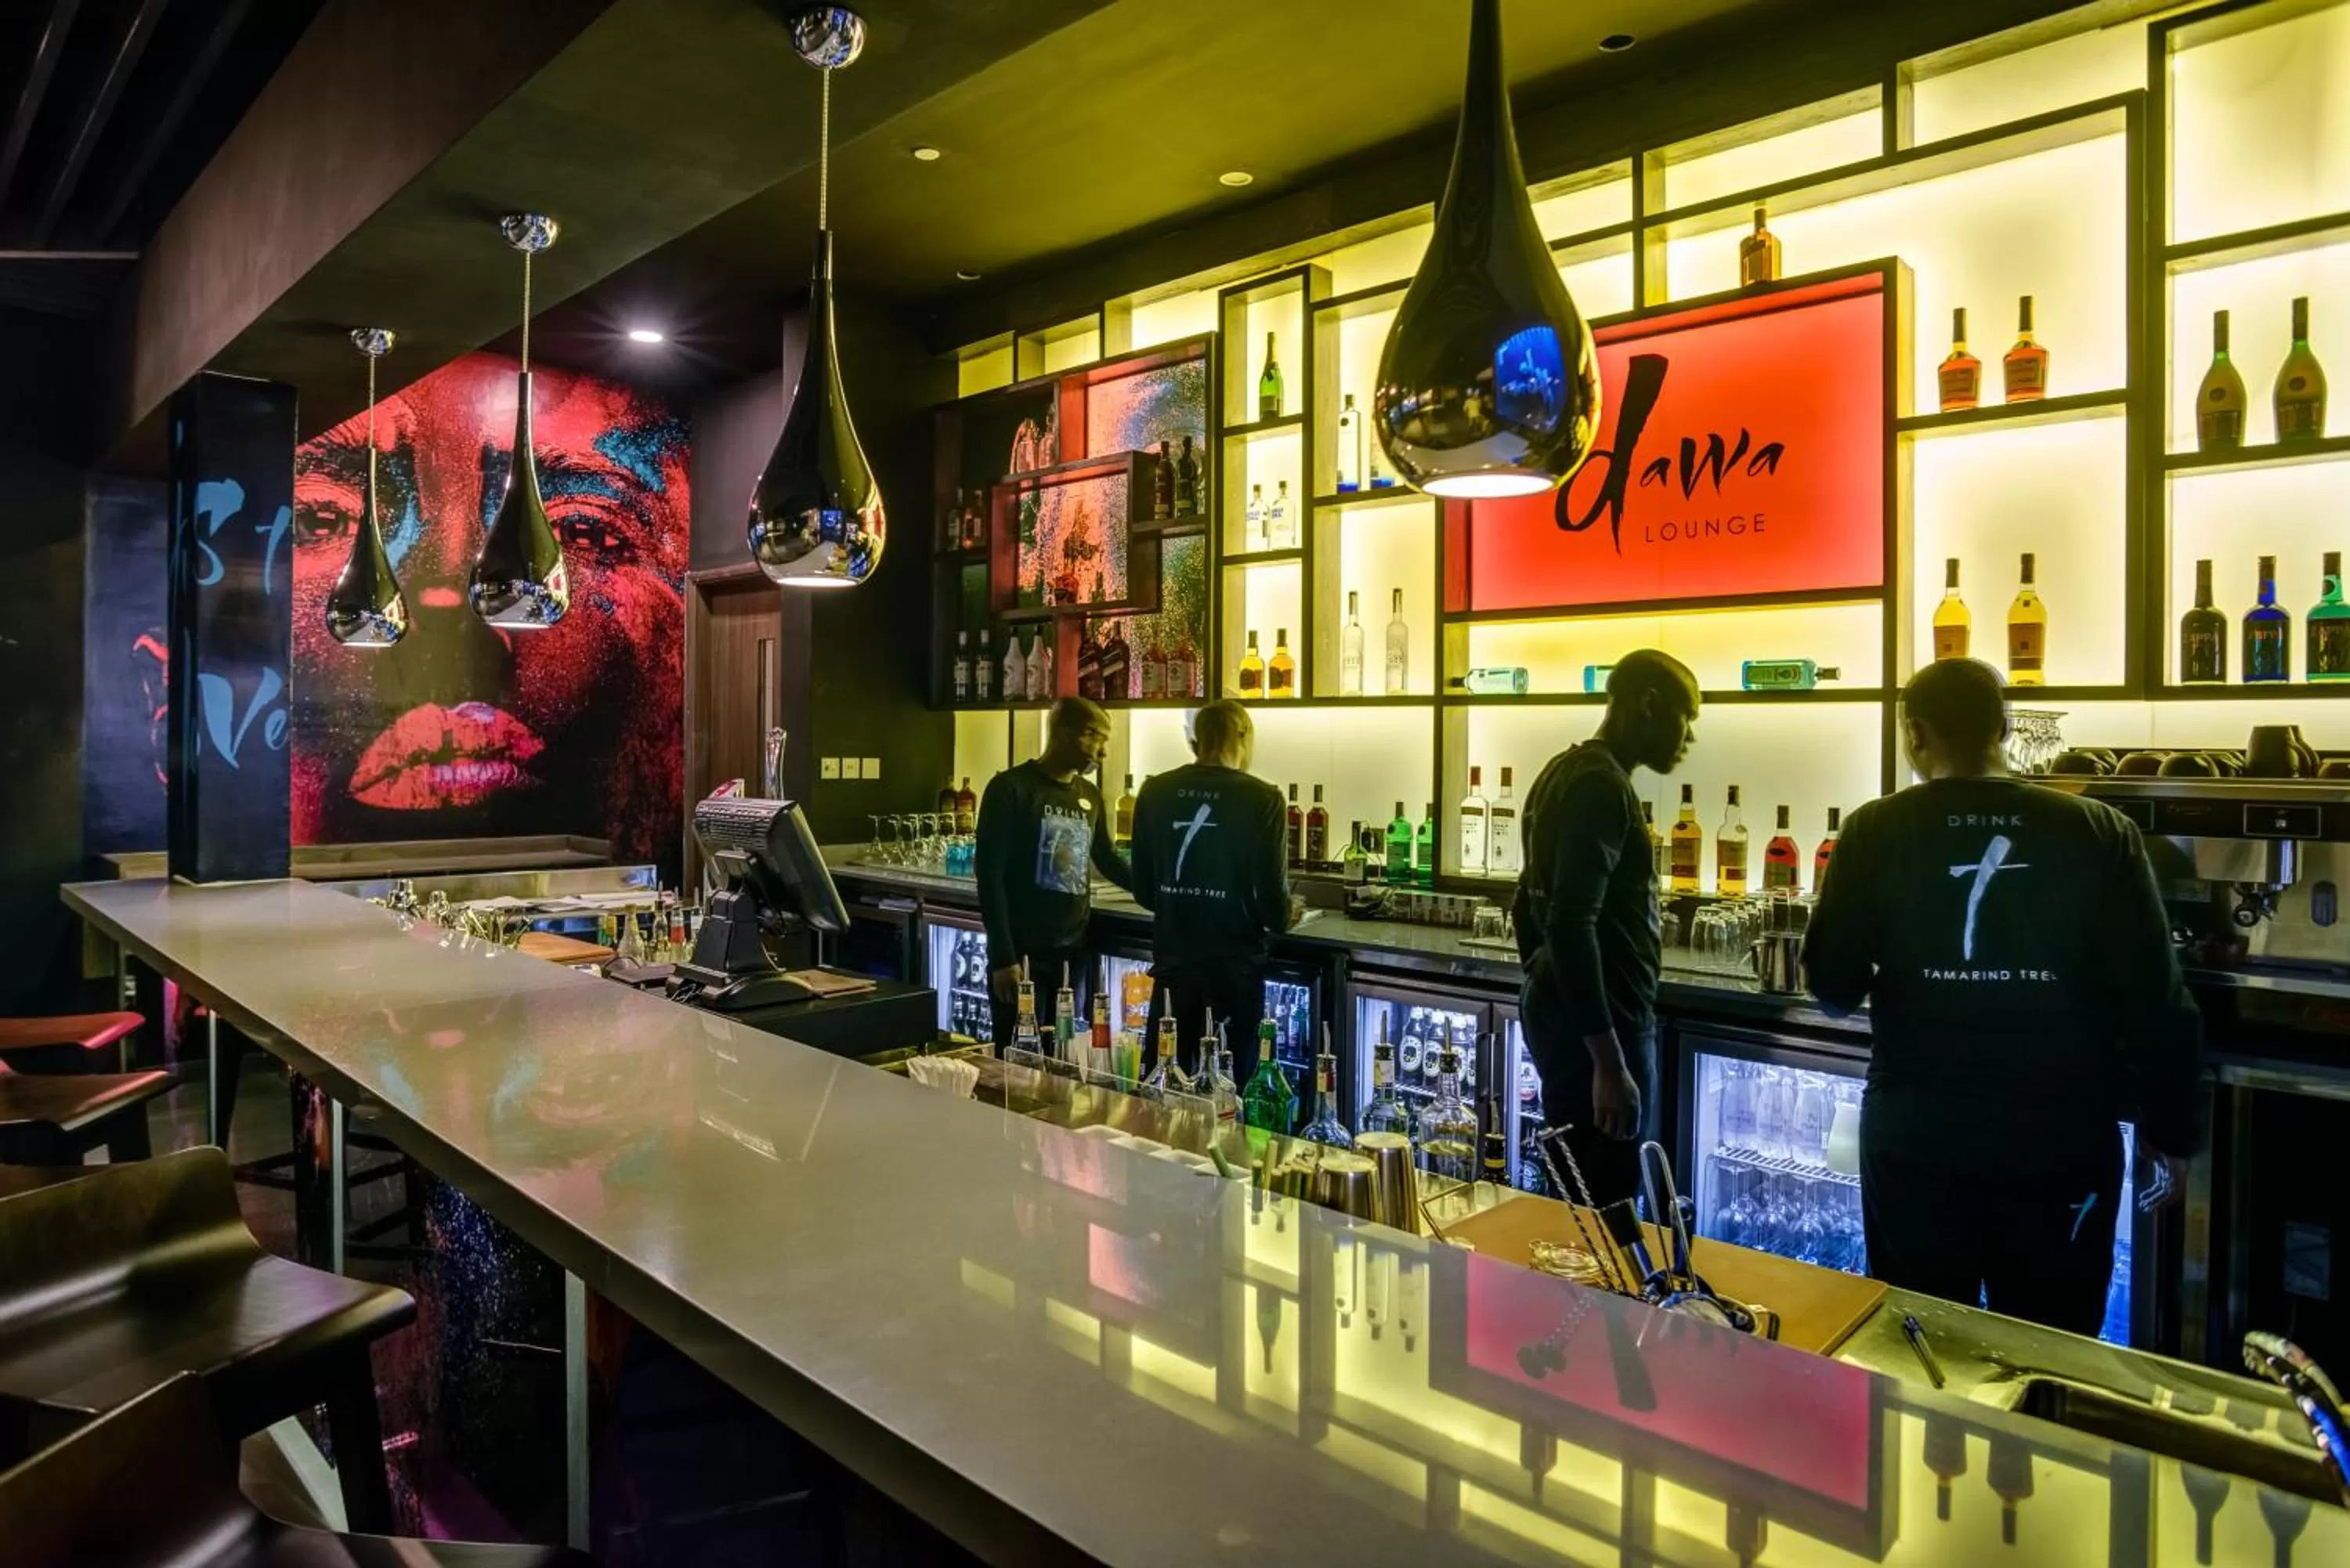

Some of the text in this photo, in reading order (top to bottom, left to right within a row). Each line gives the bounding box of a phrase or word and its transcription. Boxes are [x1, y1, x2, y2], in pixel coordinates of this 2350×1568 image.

[1645, 514, 1766, 543] LOUNGE
[1947, 815, 2023, 827] DRINK
[1923, 968, 2011, 981] TAMARIND
